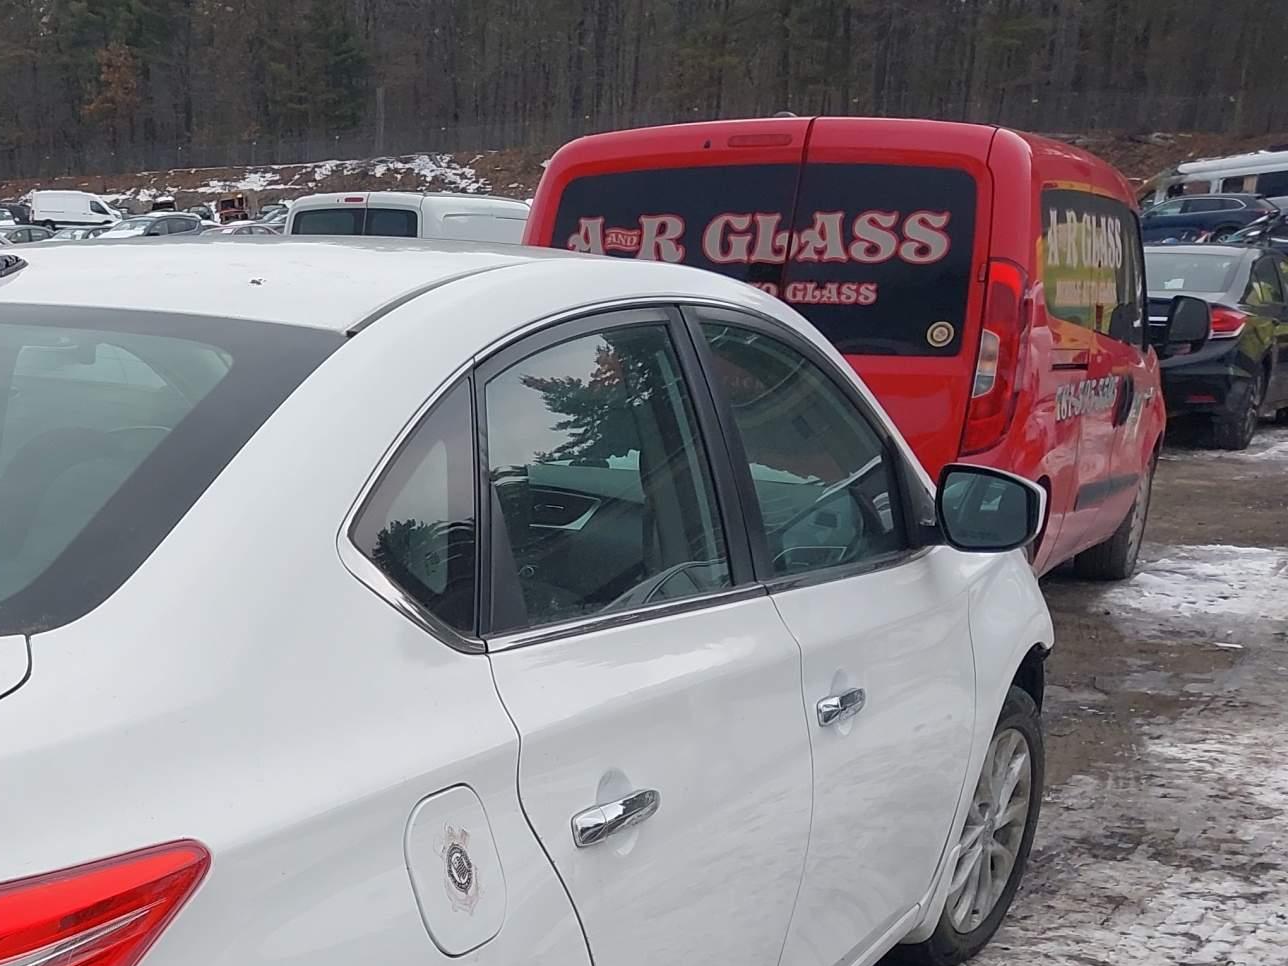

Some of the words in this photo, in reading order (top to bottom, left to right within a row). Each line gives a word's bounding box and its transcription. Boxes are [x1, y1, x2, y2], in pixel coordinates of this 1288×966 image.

[567, 216, 606, 255] A
[607, 232, 638, 246] AND
[638, 213, 686, 263] R
[703, 210, 952, 264] GLASS
[785, 281, 879, 306] GLASS
